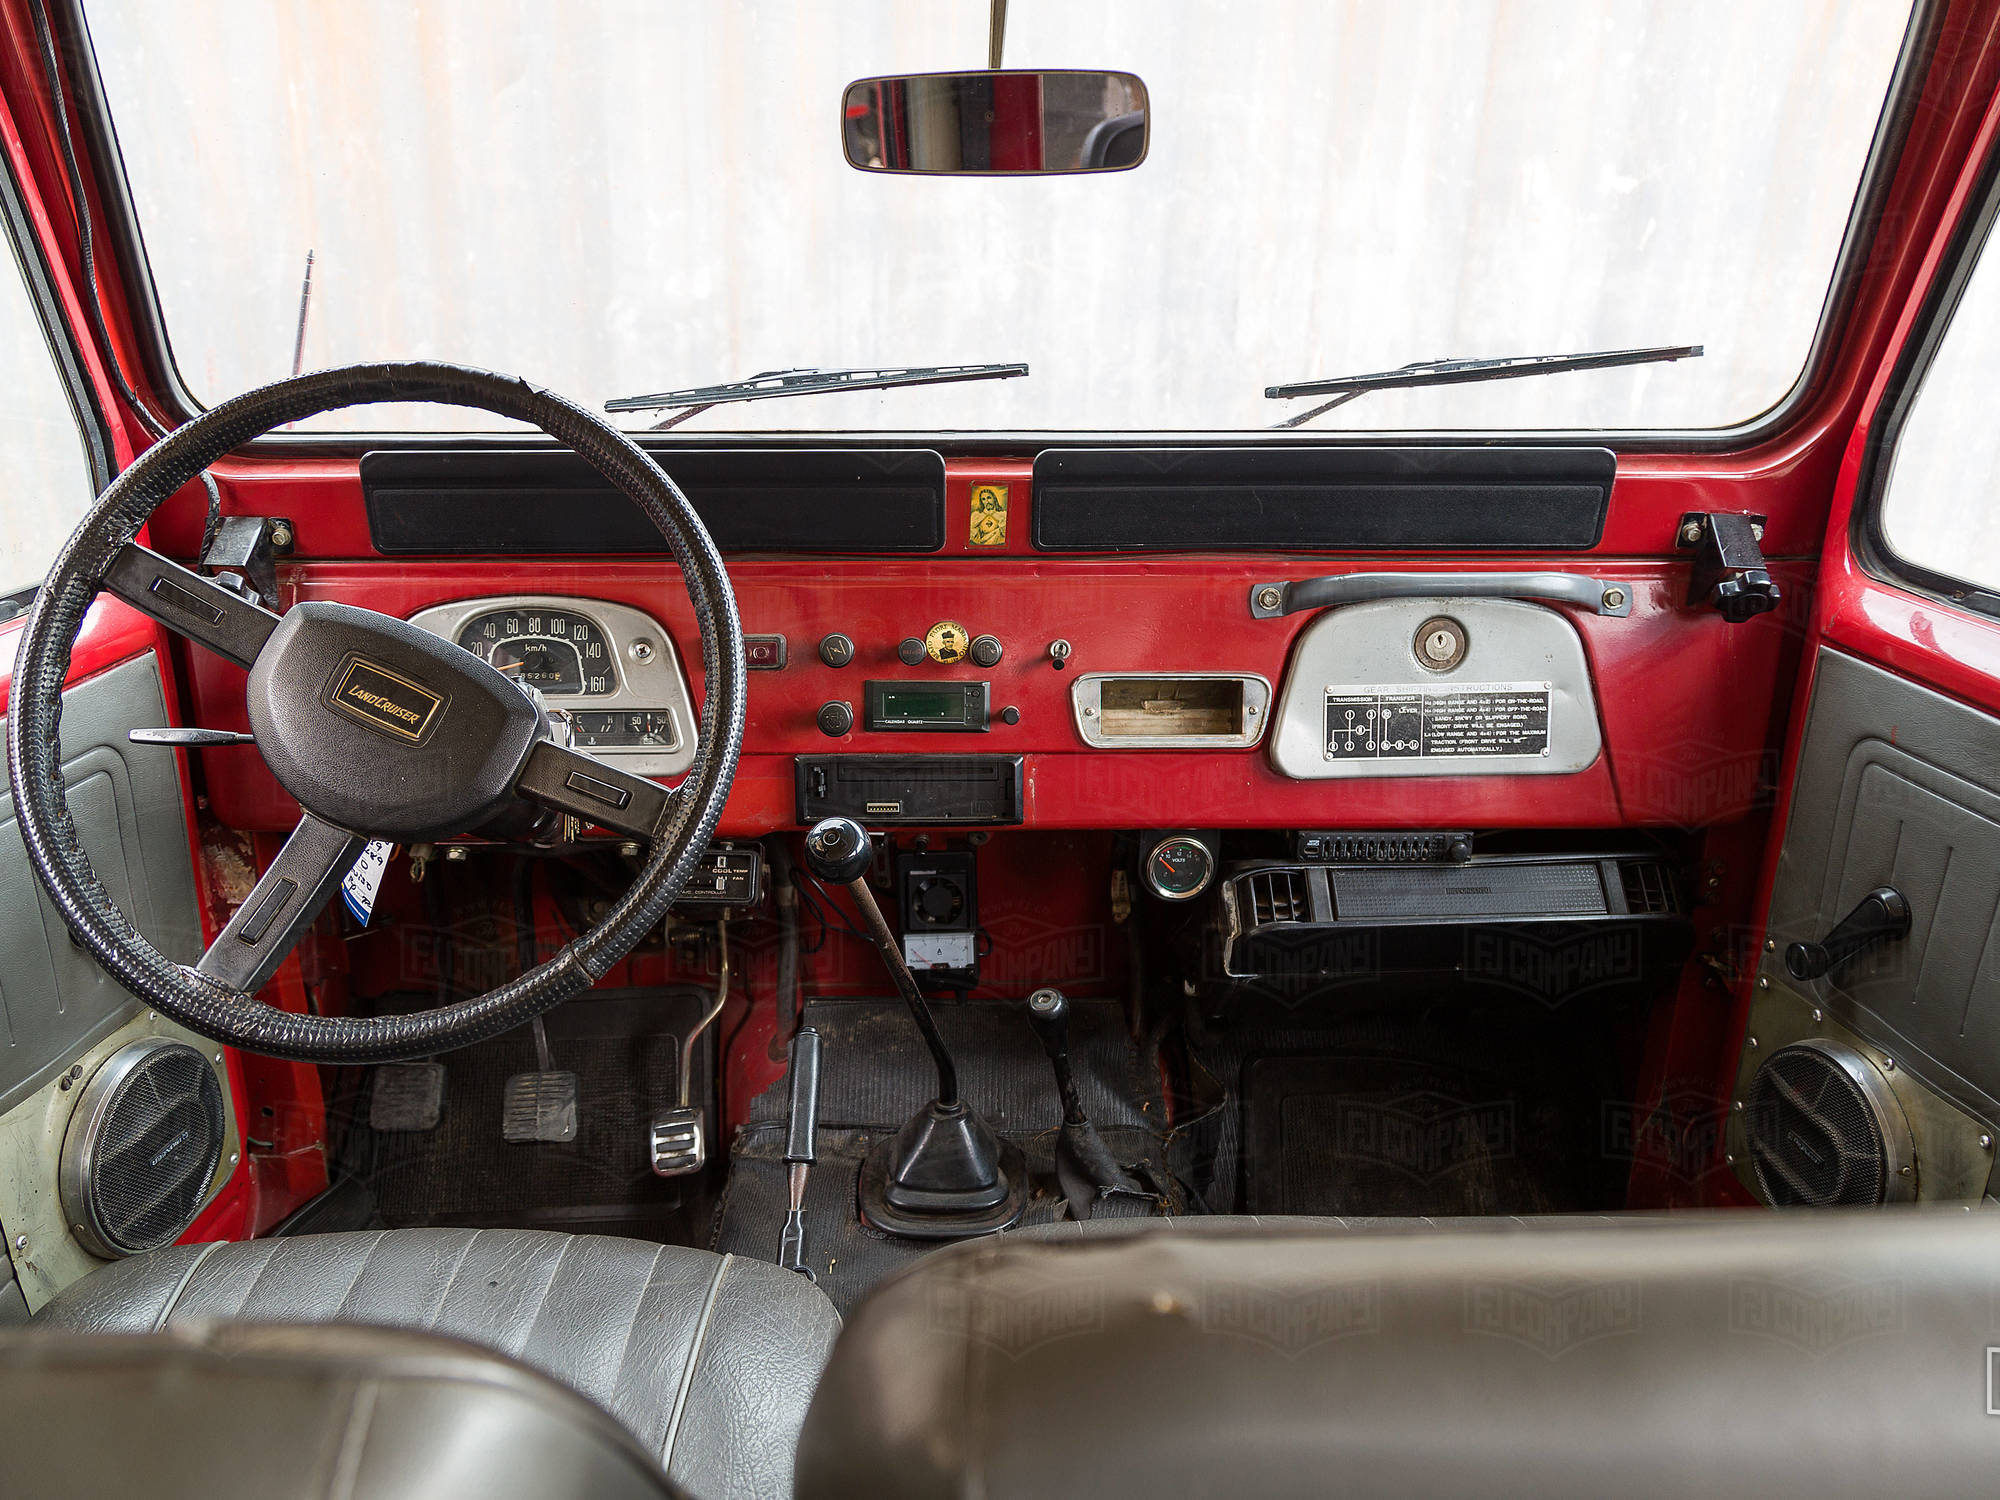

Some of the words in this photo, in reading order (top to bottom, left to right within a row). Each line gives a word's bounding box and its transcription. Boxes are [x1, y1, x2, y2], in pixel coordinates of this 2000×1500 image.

[484, 623, 496, 638] 40
[507, 618, 519, 634] 60
[529, 617, 541, 633] 80
[550, 619, 565, 634] 100
[574, 625, 588, 640] 120
[471, 641, 483, 657] 20
[525, 643, 547, 652] km/h
[586, 643, 601, 658] 140
[590, 676, 605, 692] 160
